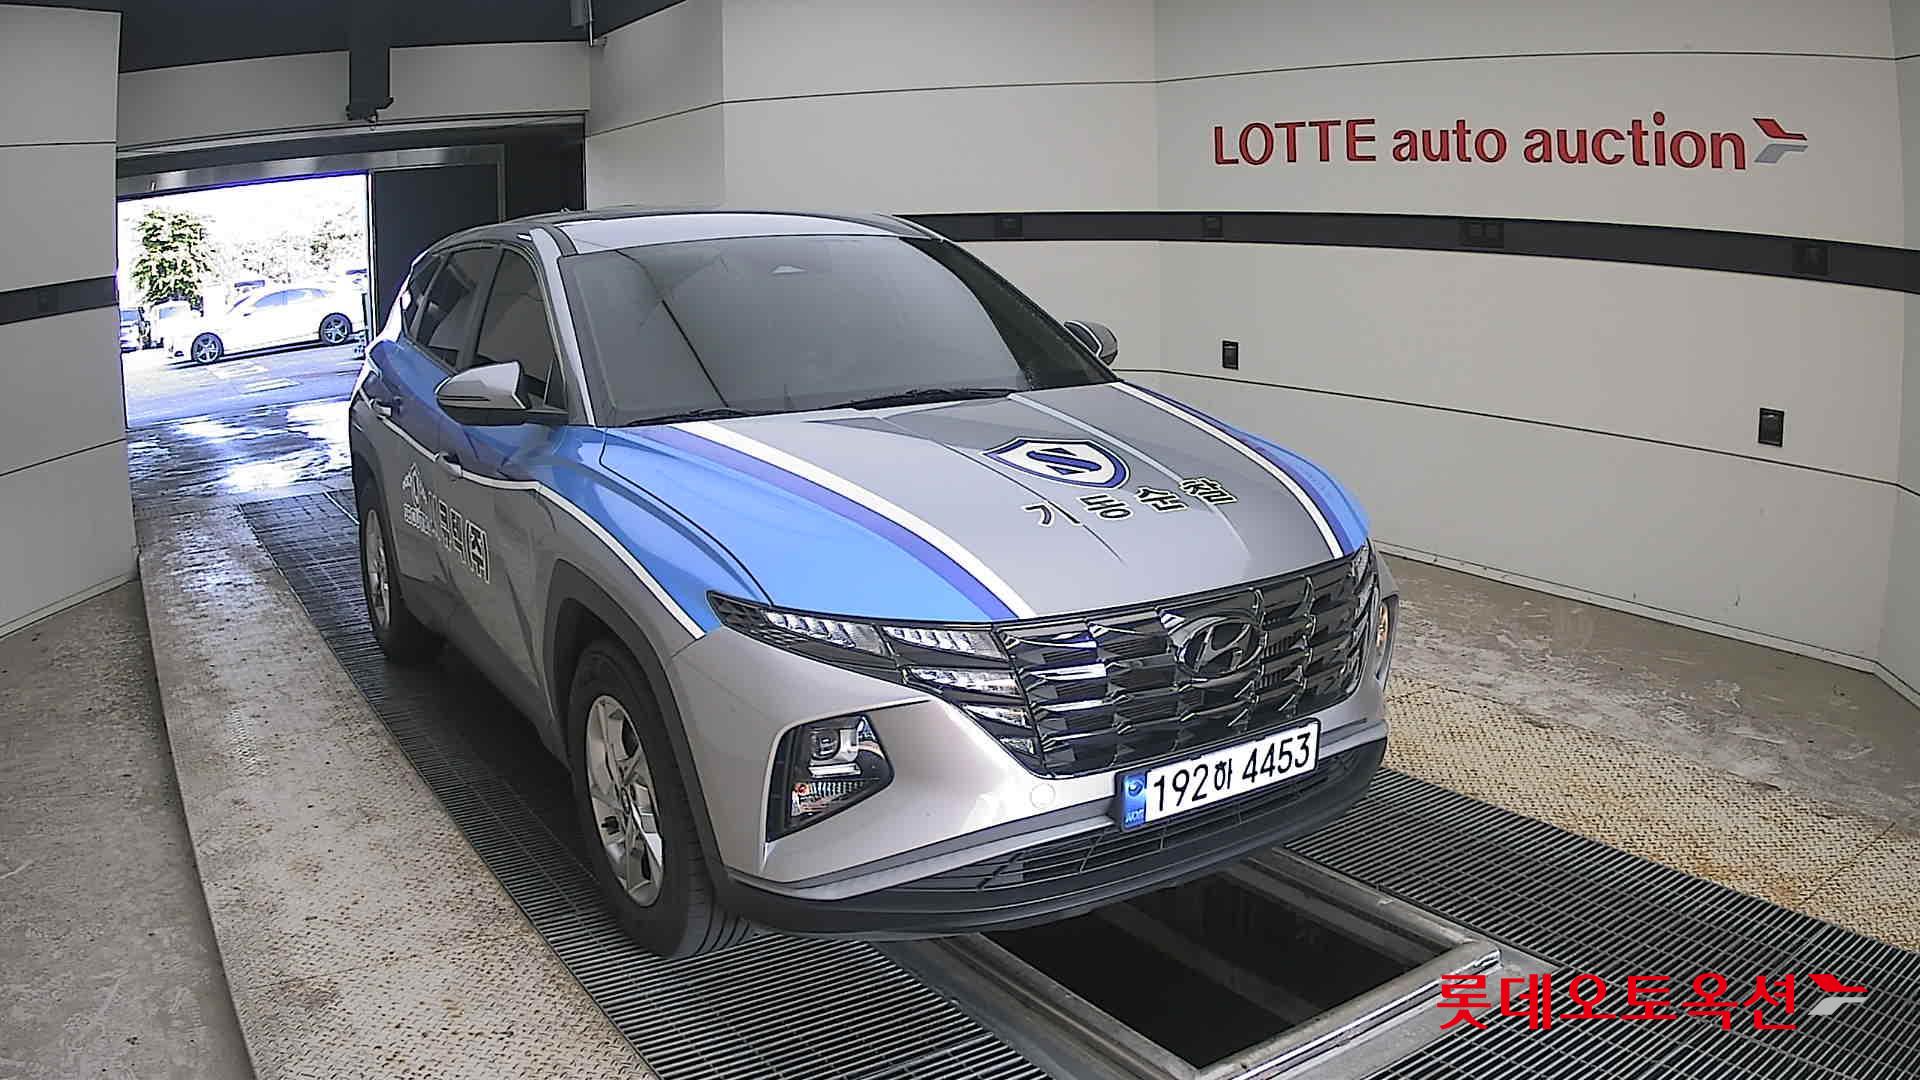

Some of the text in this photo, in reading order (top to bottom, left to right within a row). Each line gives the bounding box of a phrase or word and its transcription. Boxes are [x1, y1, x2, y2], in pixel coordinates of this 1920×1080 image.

[1213, 111, 1747, 171] LOTTE auto auction
[1022, 477, 1239, 528] 기동순찰
[1153, 731, 1312, 812] 192하 4453
